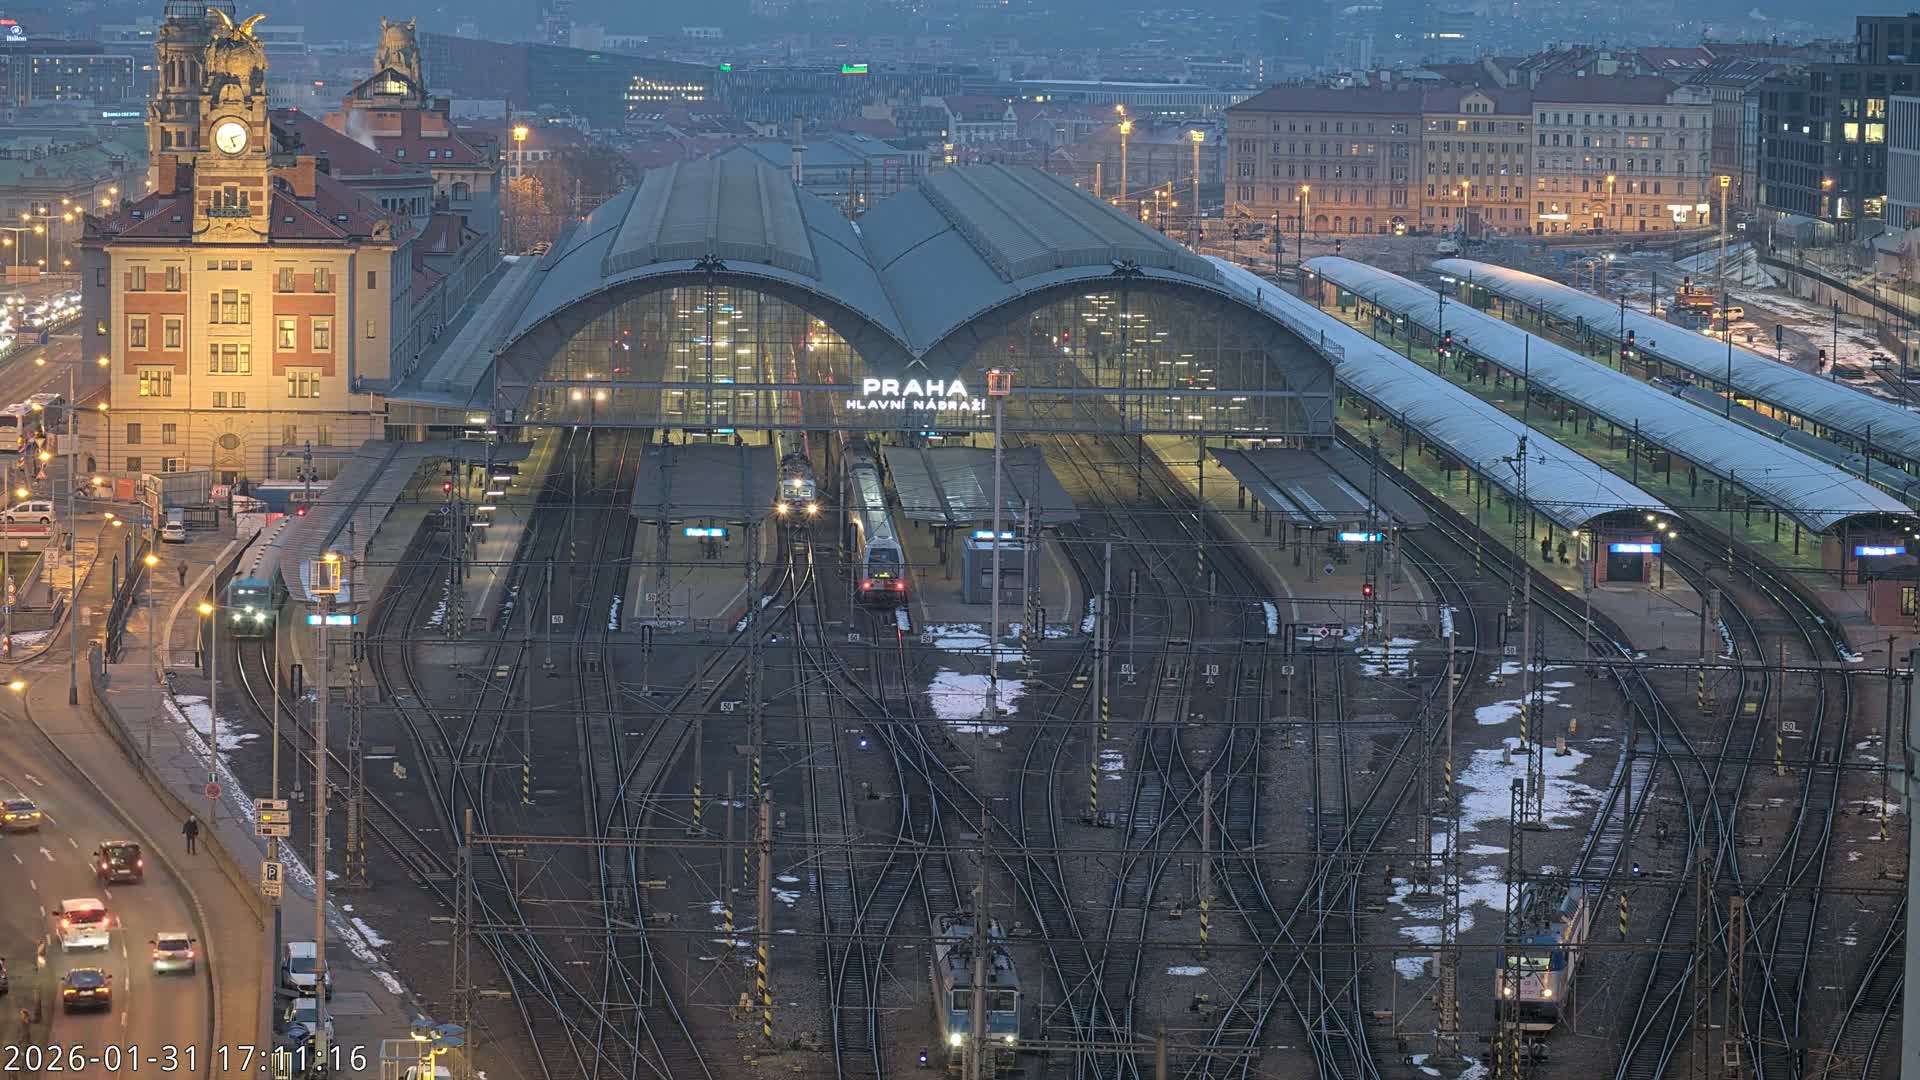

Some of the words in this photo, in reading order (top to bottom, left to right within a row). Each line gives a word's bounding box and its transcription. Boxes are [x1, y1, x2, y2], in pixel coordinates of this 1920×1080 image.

[863, 378, 968, 397] PRAHA
[846, 397, 906, 410] HLAVNÍ
[913, 397, 986, 411] NÁDRAŽÍ
[1784, 722, 1794, 730] 50
[268, 868, 276, 879] P
